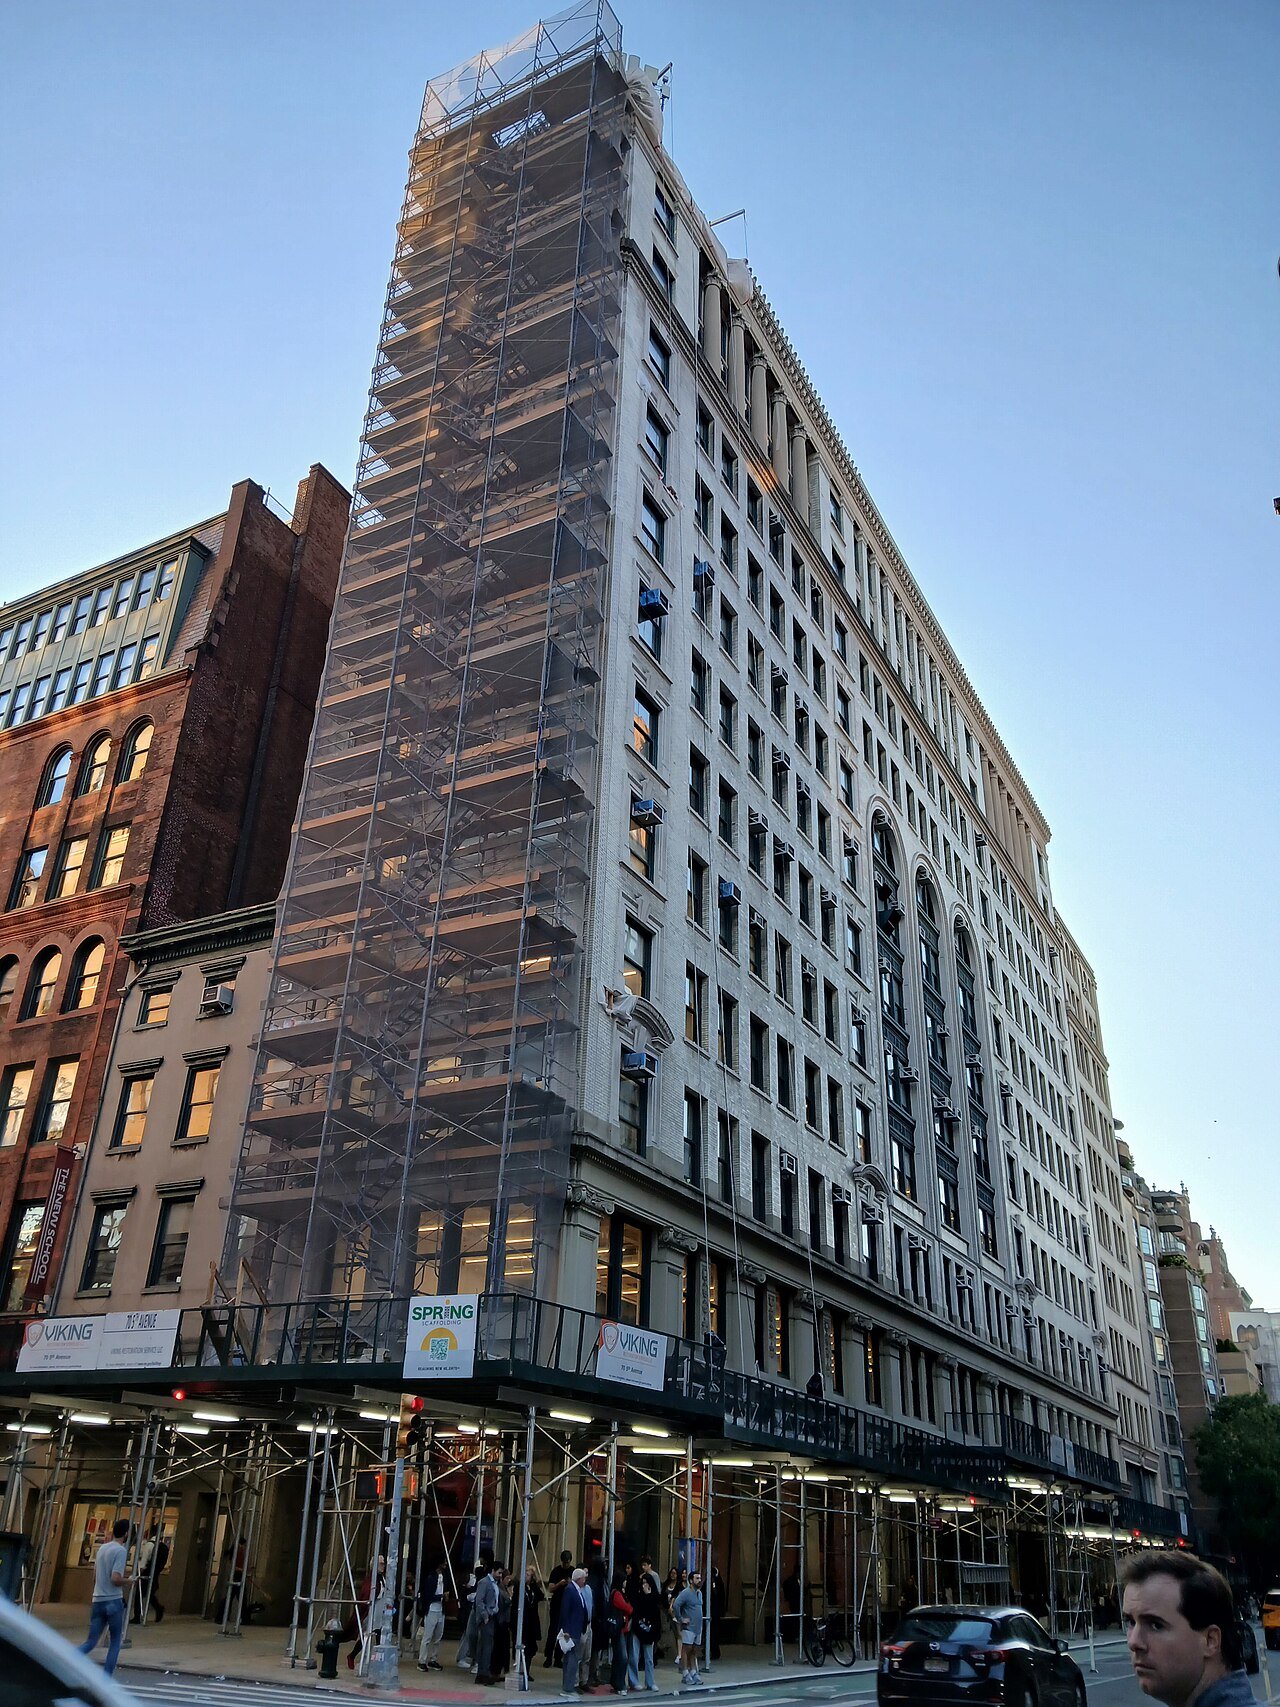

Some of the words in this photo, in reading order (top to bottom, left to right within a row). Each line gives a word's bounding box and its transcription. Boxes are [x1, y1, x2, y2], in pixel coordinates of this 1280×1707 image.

[60, 1168, 70, 1192] THE
[48, 1194, 63, 1228] NEW
[38, 1228, 56, 1281] SCHOOL
[138, 1313, 158, 1328] AVENUE
[411, 1299, 474, 1321] SPRING
[44, 1323, 93, 1341] VIKING
[620, 1331, 659, 1358] VIKING
